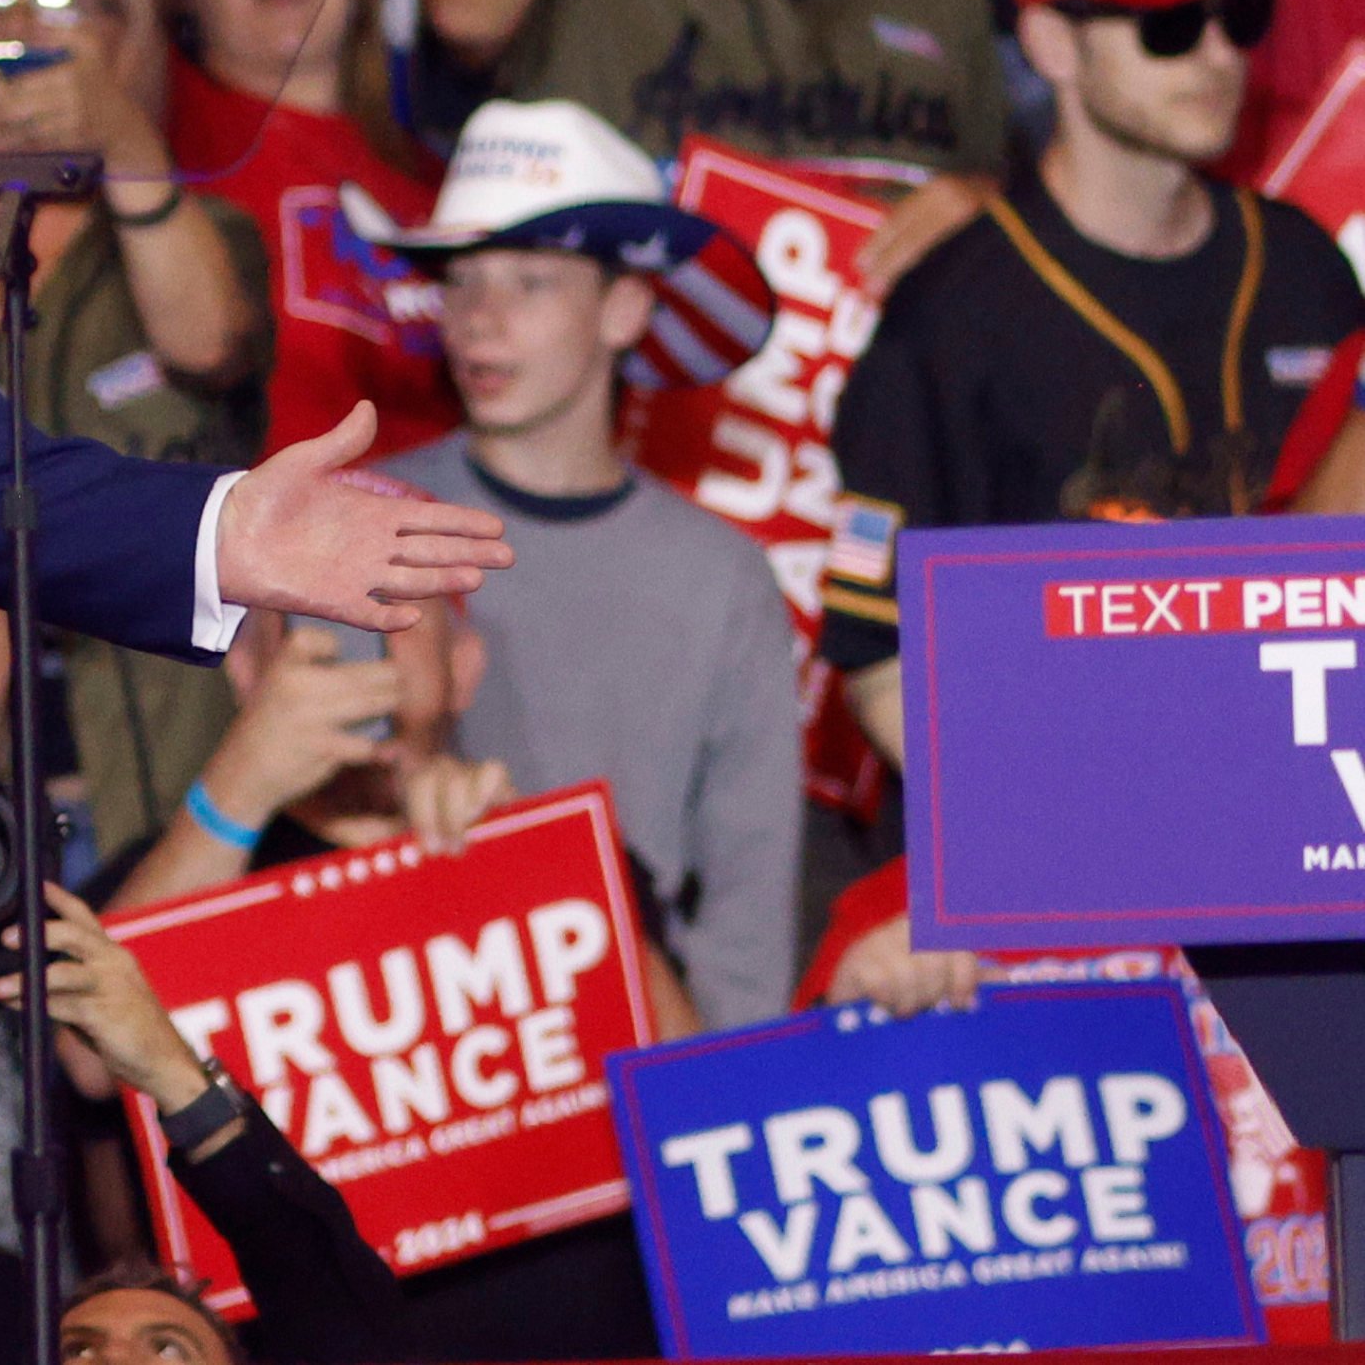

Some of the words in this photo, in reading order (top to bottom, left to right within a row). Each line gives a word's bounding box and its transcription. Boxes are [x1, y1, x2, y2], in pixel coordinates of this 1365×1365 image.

[694, 207, 844, 523] UMP
[1058, 581, 1222, 635] TEXT
[314, 1133, 428, 1184] MERICA
[661, 1071, 1189, 1221] TRUMP
[394, 1210, 488, 1267] 2024
[737, 1164, 1156, 1283] VANCE
